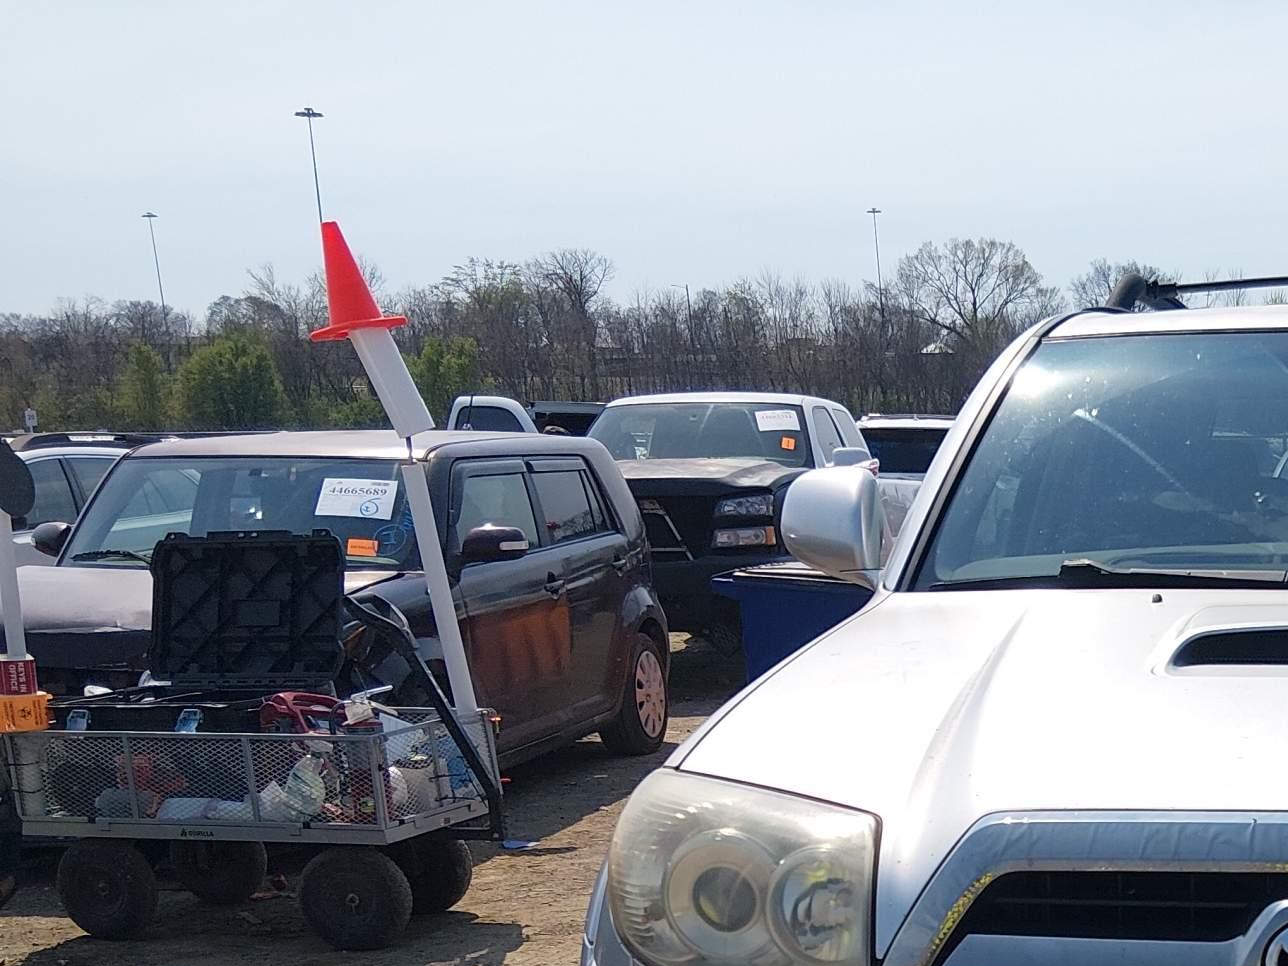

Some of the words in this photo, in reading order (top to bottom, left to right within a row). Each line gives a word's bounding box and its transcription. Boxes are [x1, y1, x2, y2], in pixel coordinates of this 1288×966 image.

[329, 486, 388, 496] 44665689
[8, 664, 18, 691] OFFICE
[17, 662, 26, 682] KEYS
[20, 684, 27, 693] IN
